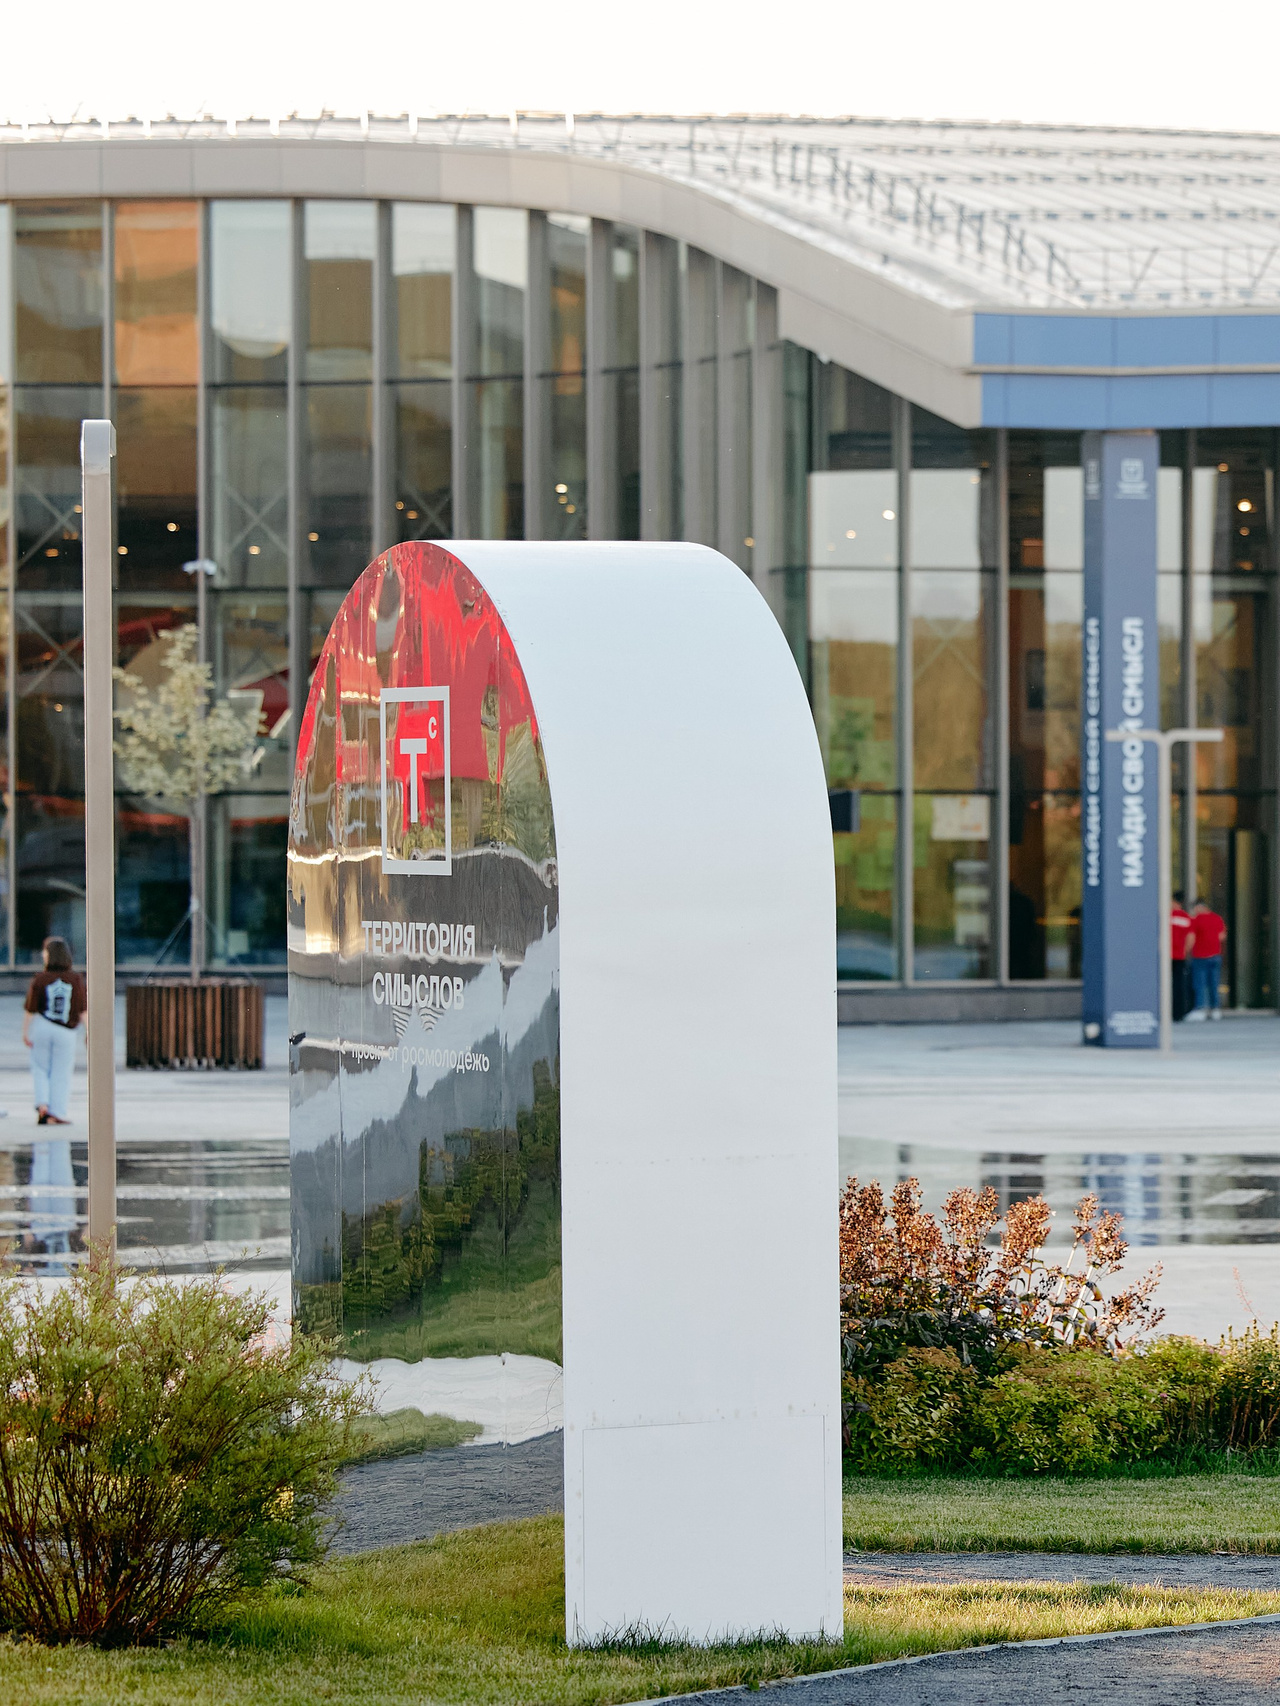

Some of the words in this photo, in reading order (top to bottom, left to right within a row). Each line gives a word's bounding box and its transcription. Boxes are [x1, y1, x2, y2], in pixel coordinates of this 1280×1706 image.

[1121, 616, 1145, 717] СМЫСЛ
[1117, 794, 1147, 888] НАЙДИ
[361, 920, 476, 958] ТЕРРИТОРИЯ
[372, 971, 465, 1010] СМЫСЛОВ
[402, 1045, 490, 1074] росмолодёжь
